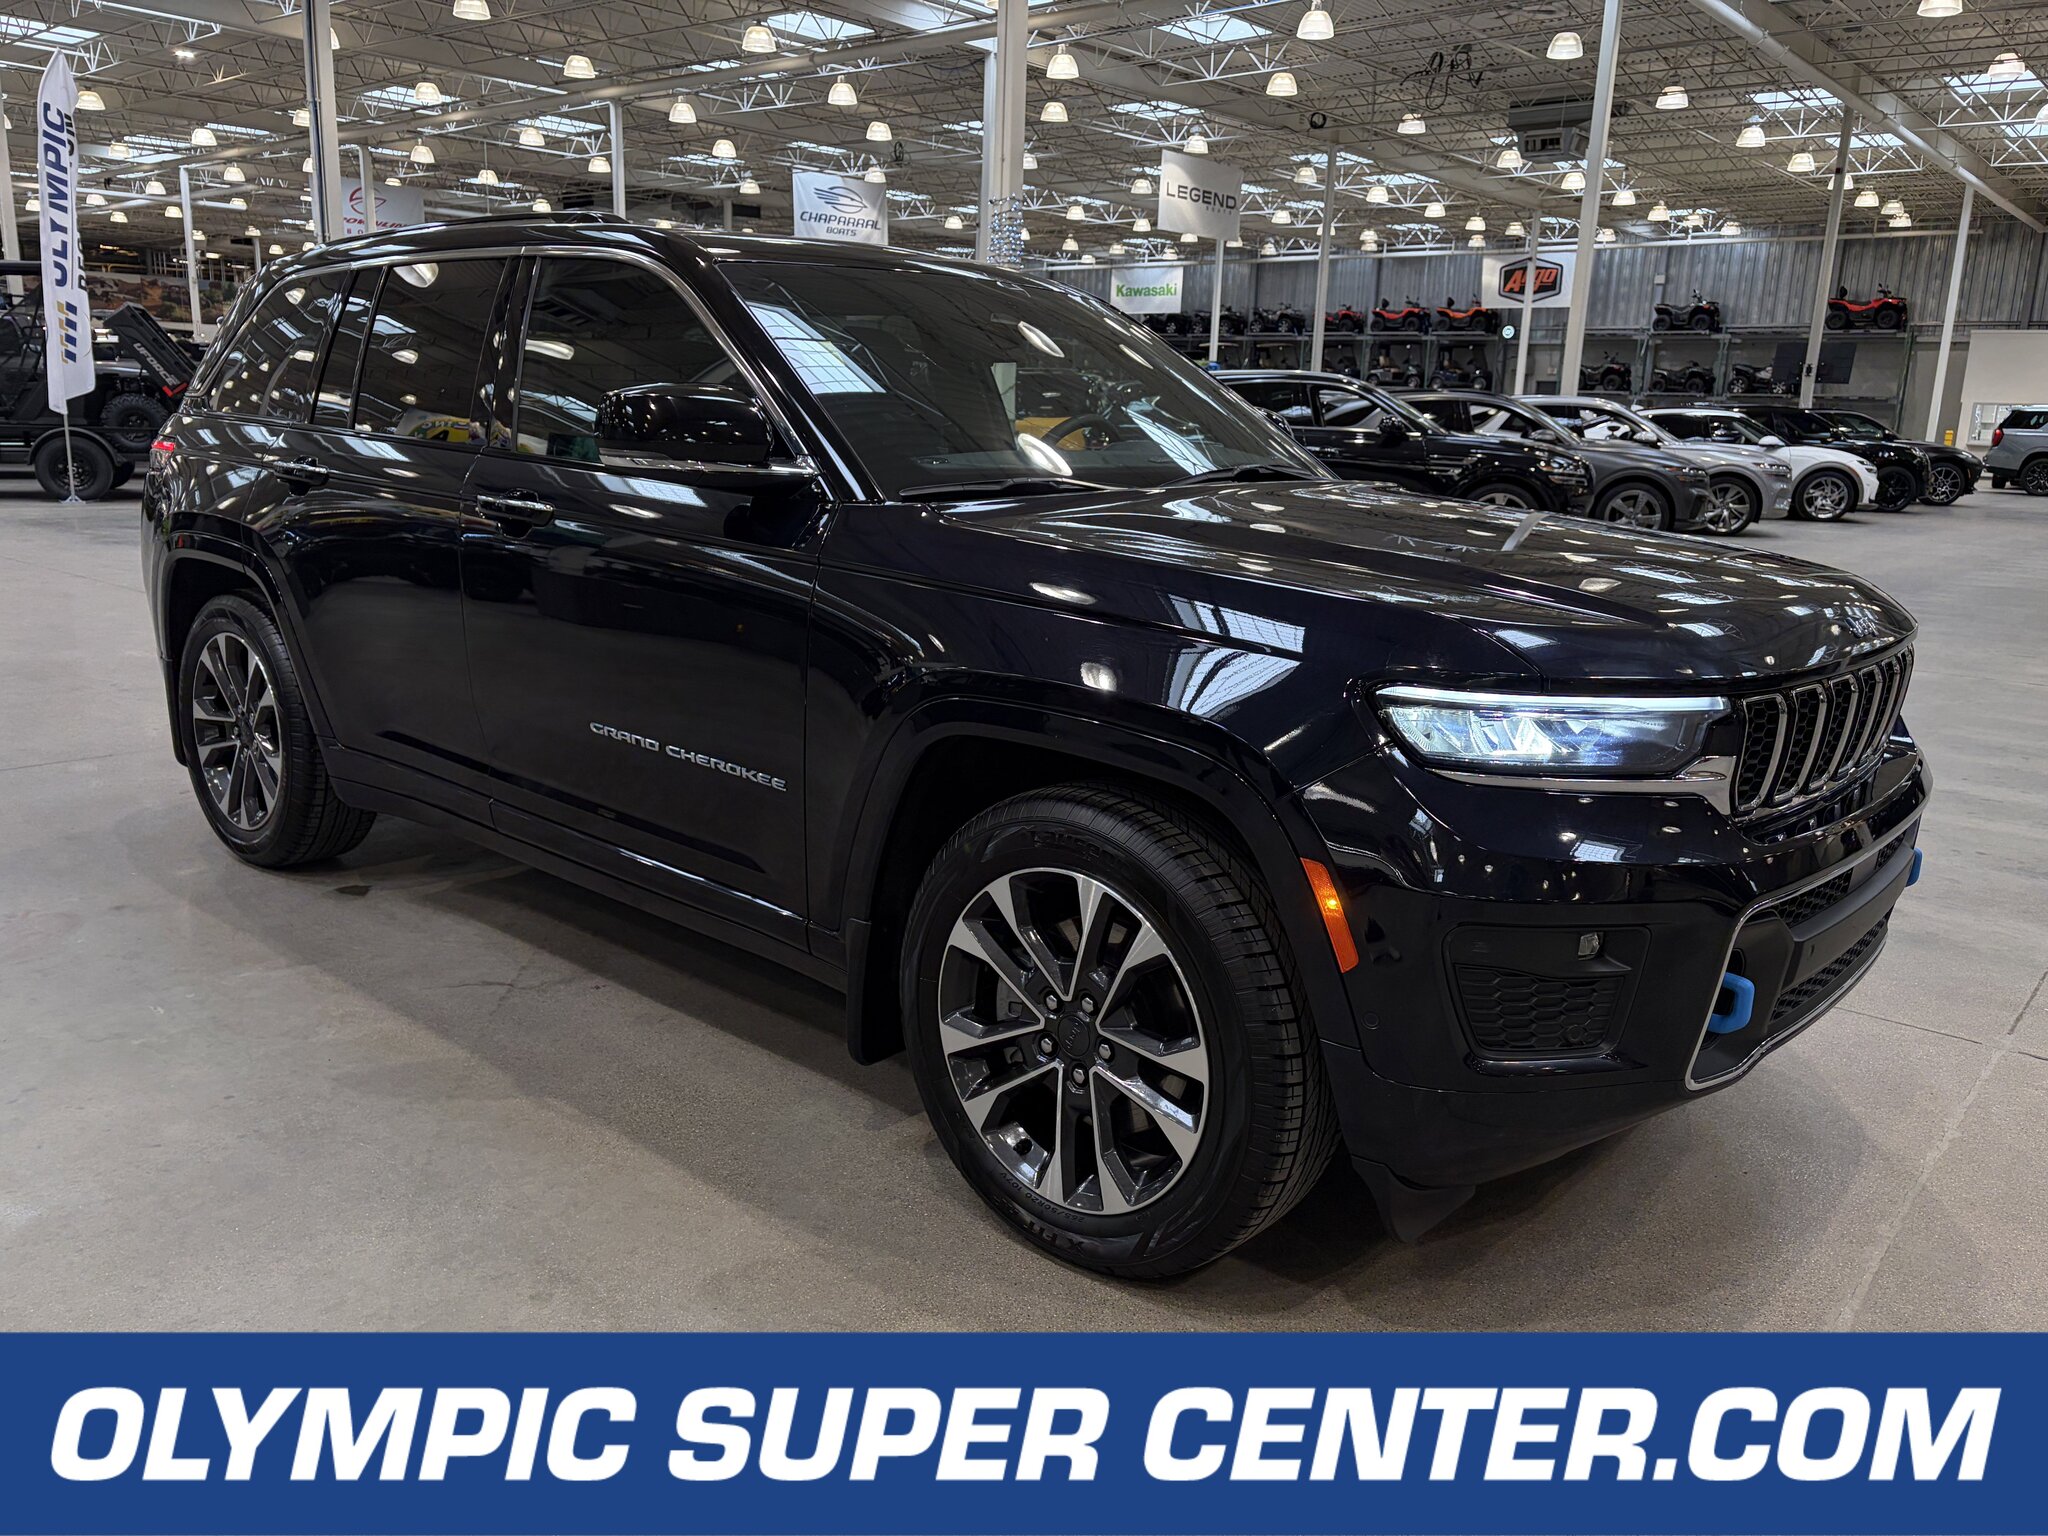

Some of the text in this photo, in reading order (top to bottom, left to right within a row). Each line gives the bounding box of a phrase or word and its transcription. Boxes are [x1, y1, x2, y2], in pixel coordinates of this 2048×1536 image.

[42, 102, 68, 288] OLYMPIC
[1166, 181, 1237, 210] LEGEND
[800, 211, 881, 230] CHAPARRAL
[826, 226, 857, 237] BOATS
[1116, 283, 1177, 297] Kawasaki
[589, 721, 787, 792] GRAND CHEROKEE
